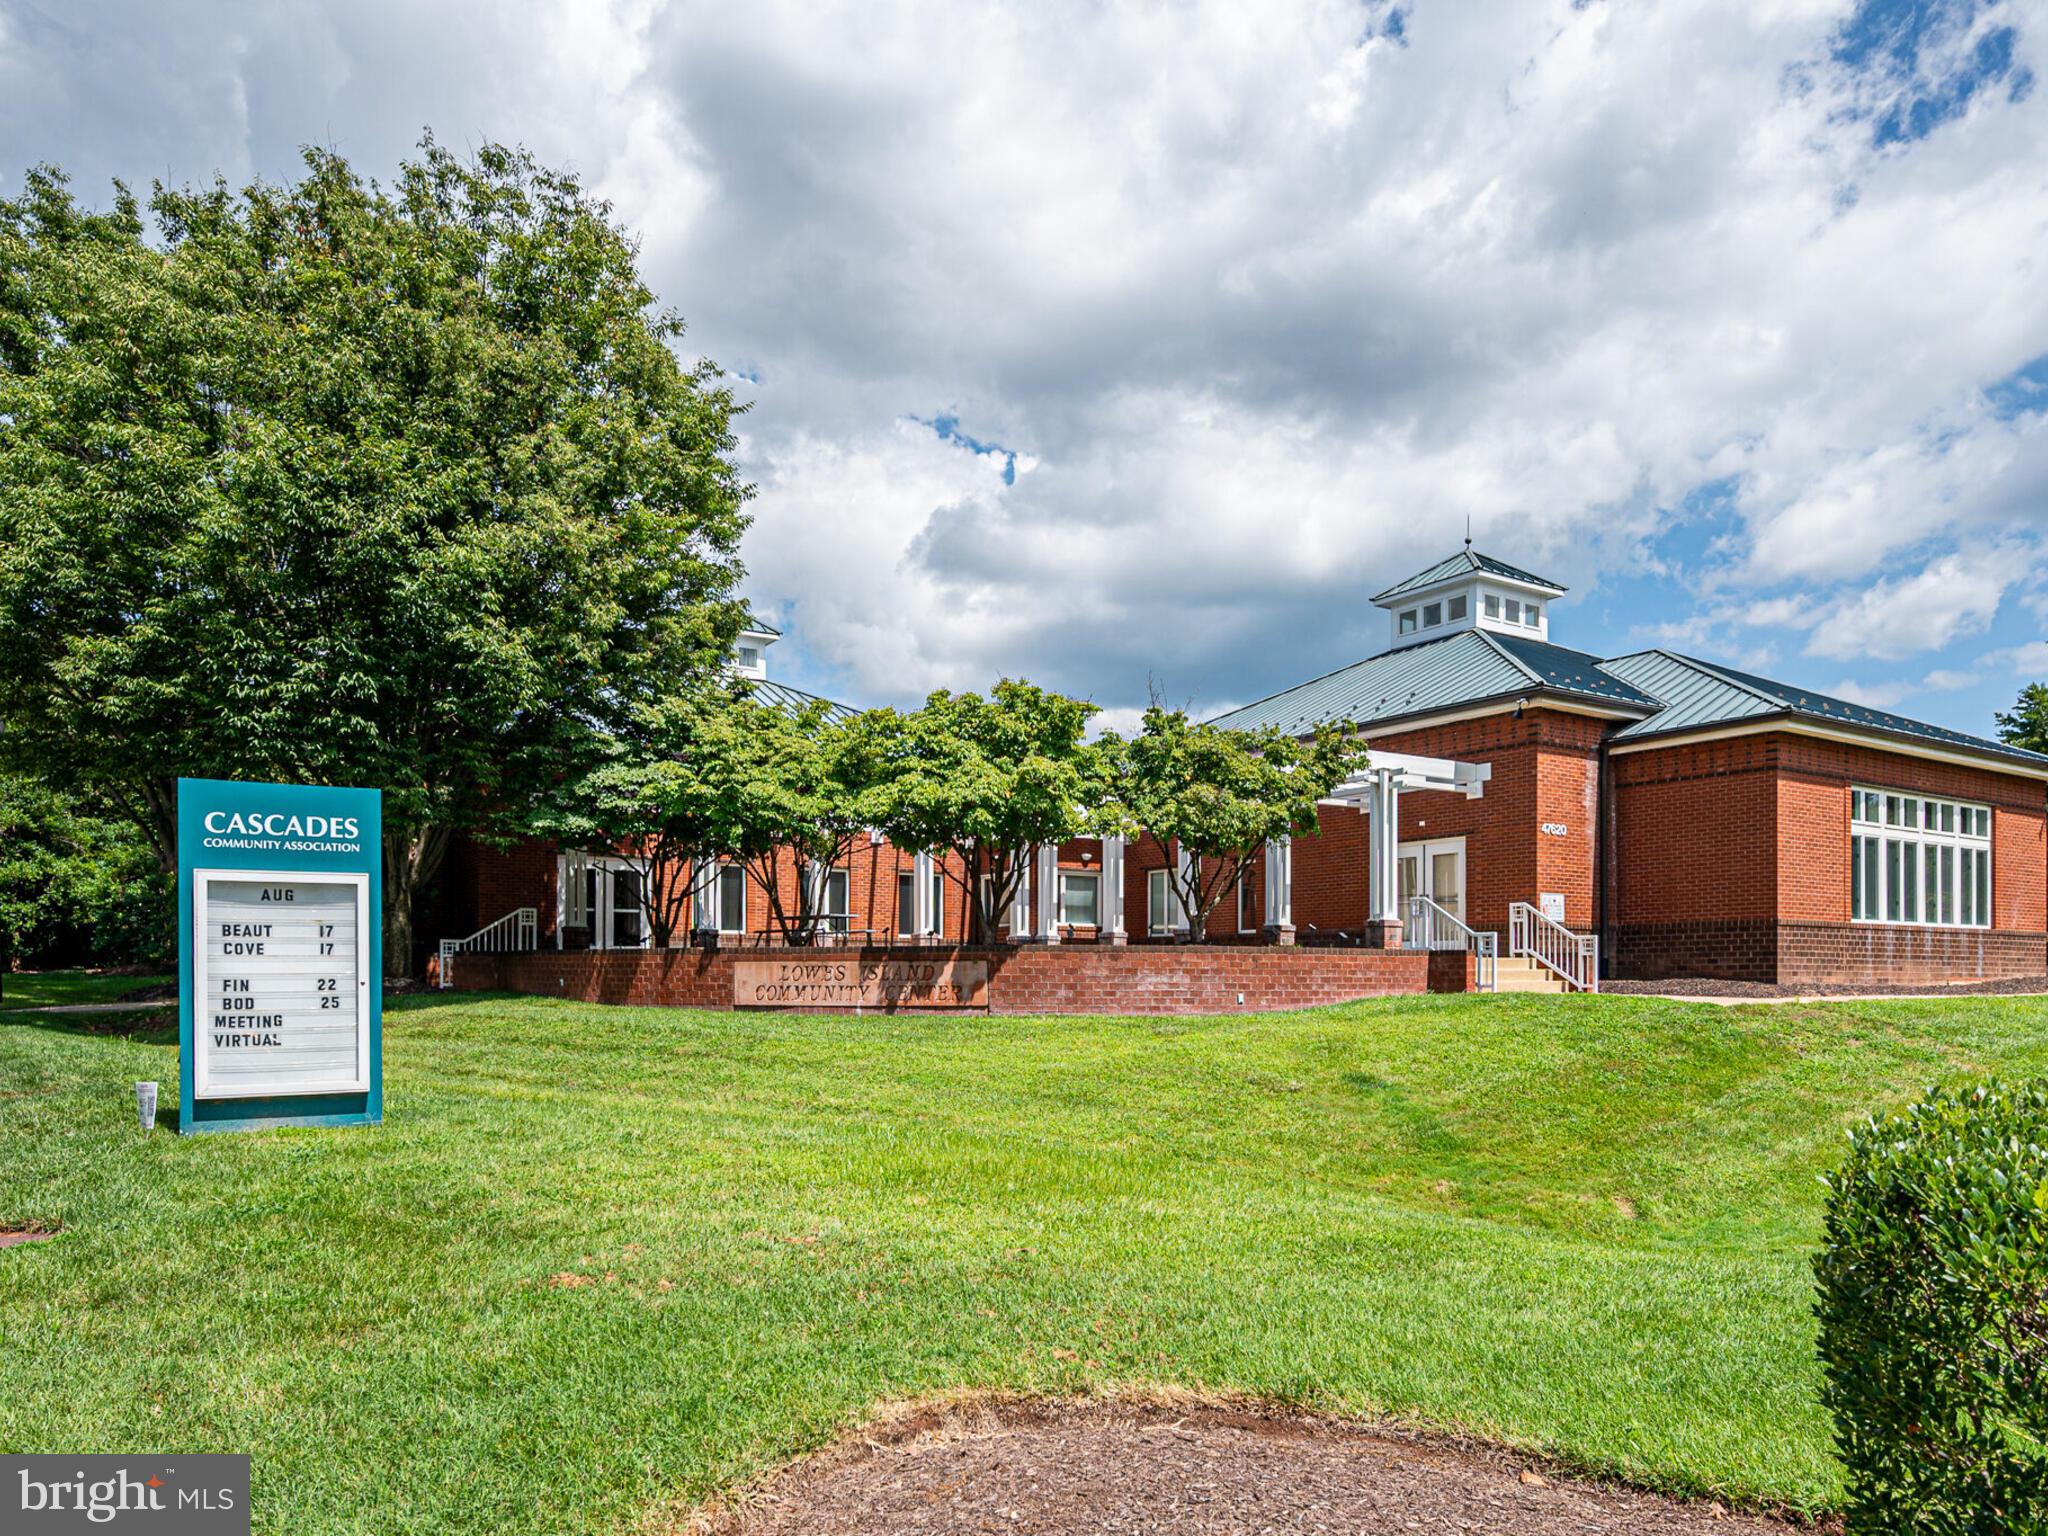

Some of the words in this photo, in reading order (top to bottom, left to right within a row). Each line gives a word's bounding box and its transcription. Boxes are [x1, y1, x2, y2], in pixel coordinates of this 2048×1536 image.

[204, 811, 359, 839] CASCADES
[1541, 823, 1567, 836] 47620
[203, 837, 281, 850] COMMUNITY
[283, 841, 360, 852] ASSOCIATION
[261, 889, 294, 901] AUG
[222, 925, 272, 937] BEAUT
[319, 925, 333, 937] 17
[223, 943, 264, 955] COVE
[320, 943, 334, 955] 17
[779, 965, 846, 982] LOWES
[860, 965, 936, 982] ISLAND
[223, 980, 249, 992] FIN
[318, 979, 336, 991] 22
[755, 984, 871, 1002] COMMUNITY
[884, 984, 963, 1002] CENTER
[223, 998, 254, 1010] BOD
[321, 997, 340, 1009] 25
[214, 1014, 283, 1029] MEETING
[214, 1033, 282, 1047] VIRTUAL
